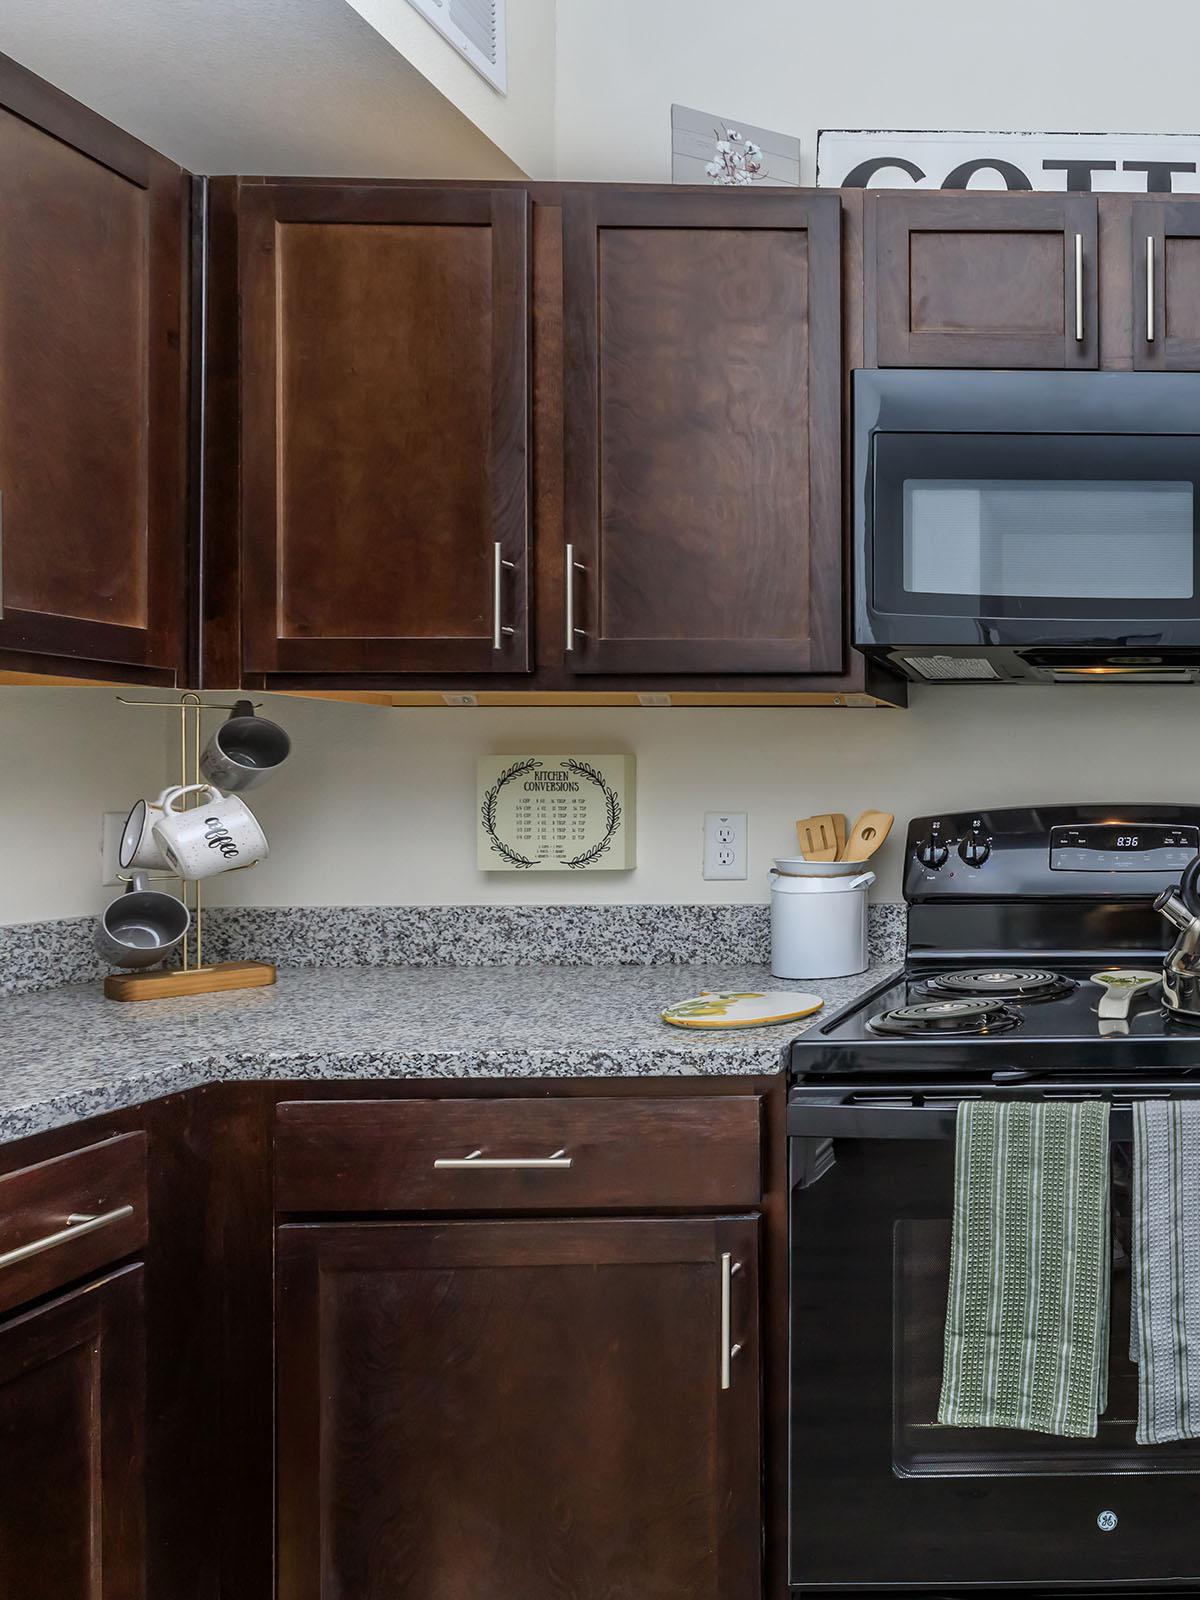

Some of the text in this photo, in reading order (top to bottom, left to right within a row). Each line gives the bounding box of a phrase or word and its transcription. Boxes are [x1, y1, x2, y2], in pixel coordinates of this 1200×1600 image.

[534, 771, 569, 781] KITCHEN
[524, 782, 580, 792] CONVERSIONS
[204, 816, 239, 859] coffee
[1116, 836, 1139, 847] 8:36
